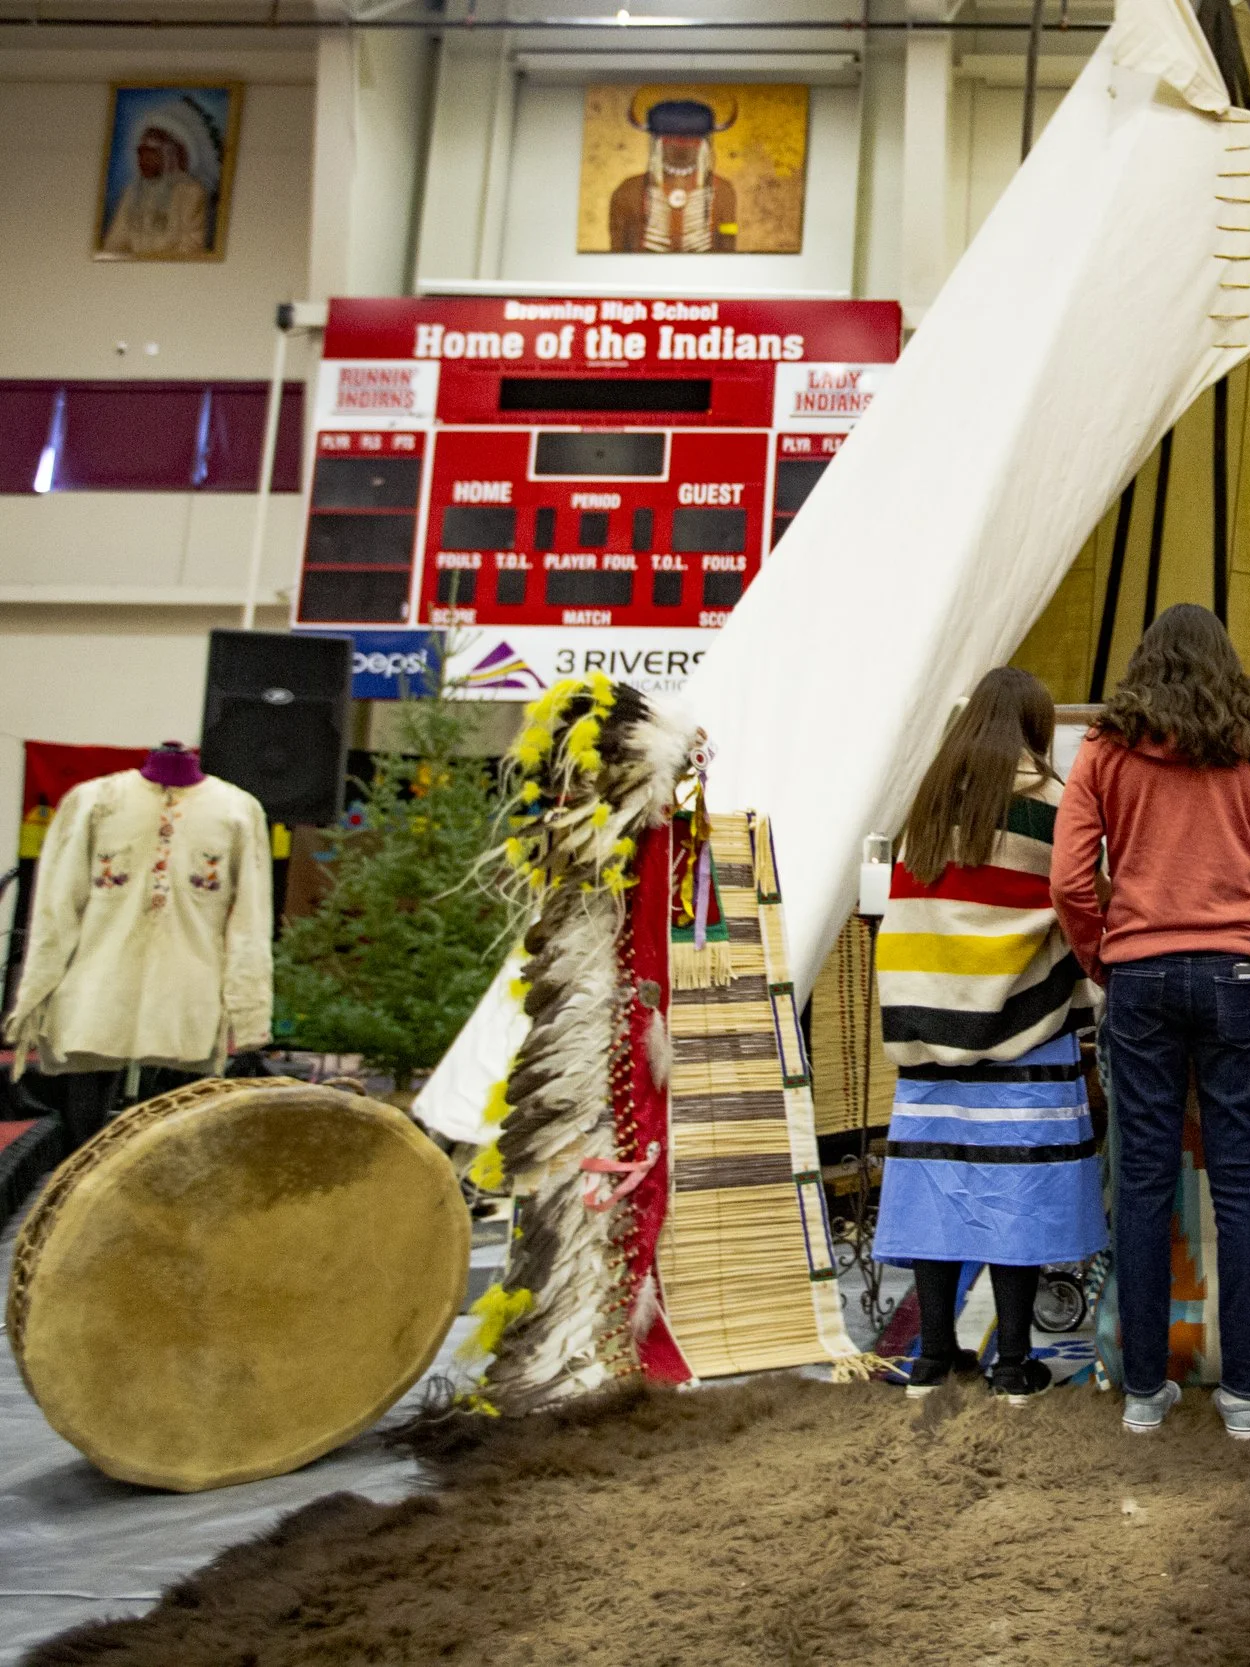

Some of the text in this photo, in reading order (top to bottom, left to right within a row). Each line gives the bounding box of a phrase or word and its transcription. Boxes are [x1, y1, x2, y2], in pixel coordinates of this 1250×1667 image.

[504, 301, 718, 323] Browning High School
[413, 324, 804, 361] Home of the Indians
[807, 368, 862, 389] LADY
[336, 390, 415, 410] INDIANS
[782, 437, 811, 453] PLYR
[453, 481, 513, 503] HOME
[678, 483, 745, 505] GUEST
[571, 493, 621, 509] PERIOD
[436, 552, 482, 569] FOULS
[495, 552, 533, 570] T.O.L.
[544, 554, 639, 571] PLAYER FOUL
[651, 554, 689, 571] T.O.L.
[702, 556, 747, 571] FOULS
[562, 610, 612, 625] MATCH
[698, 611, 731, 627] SCO
[556, 648, 576, 674] 3
